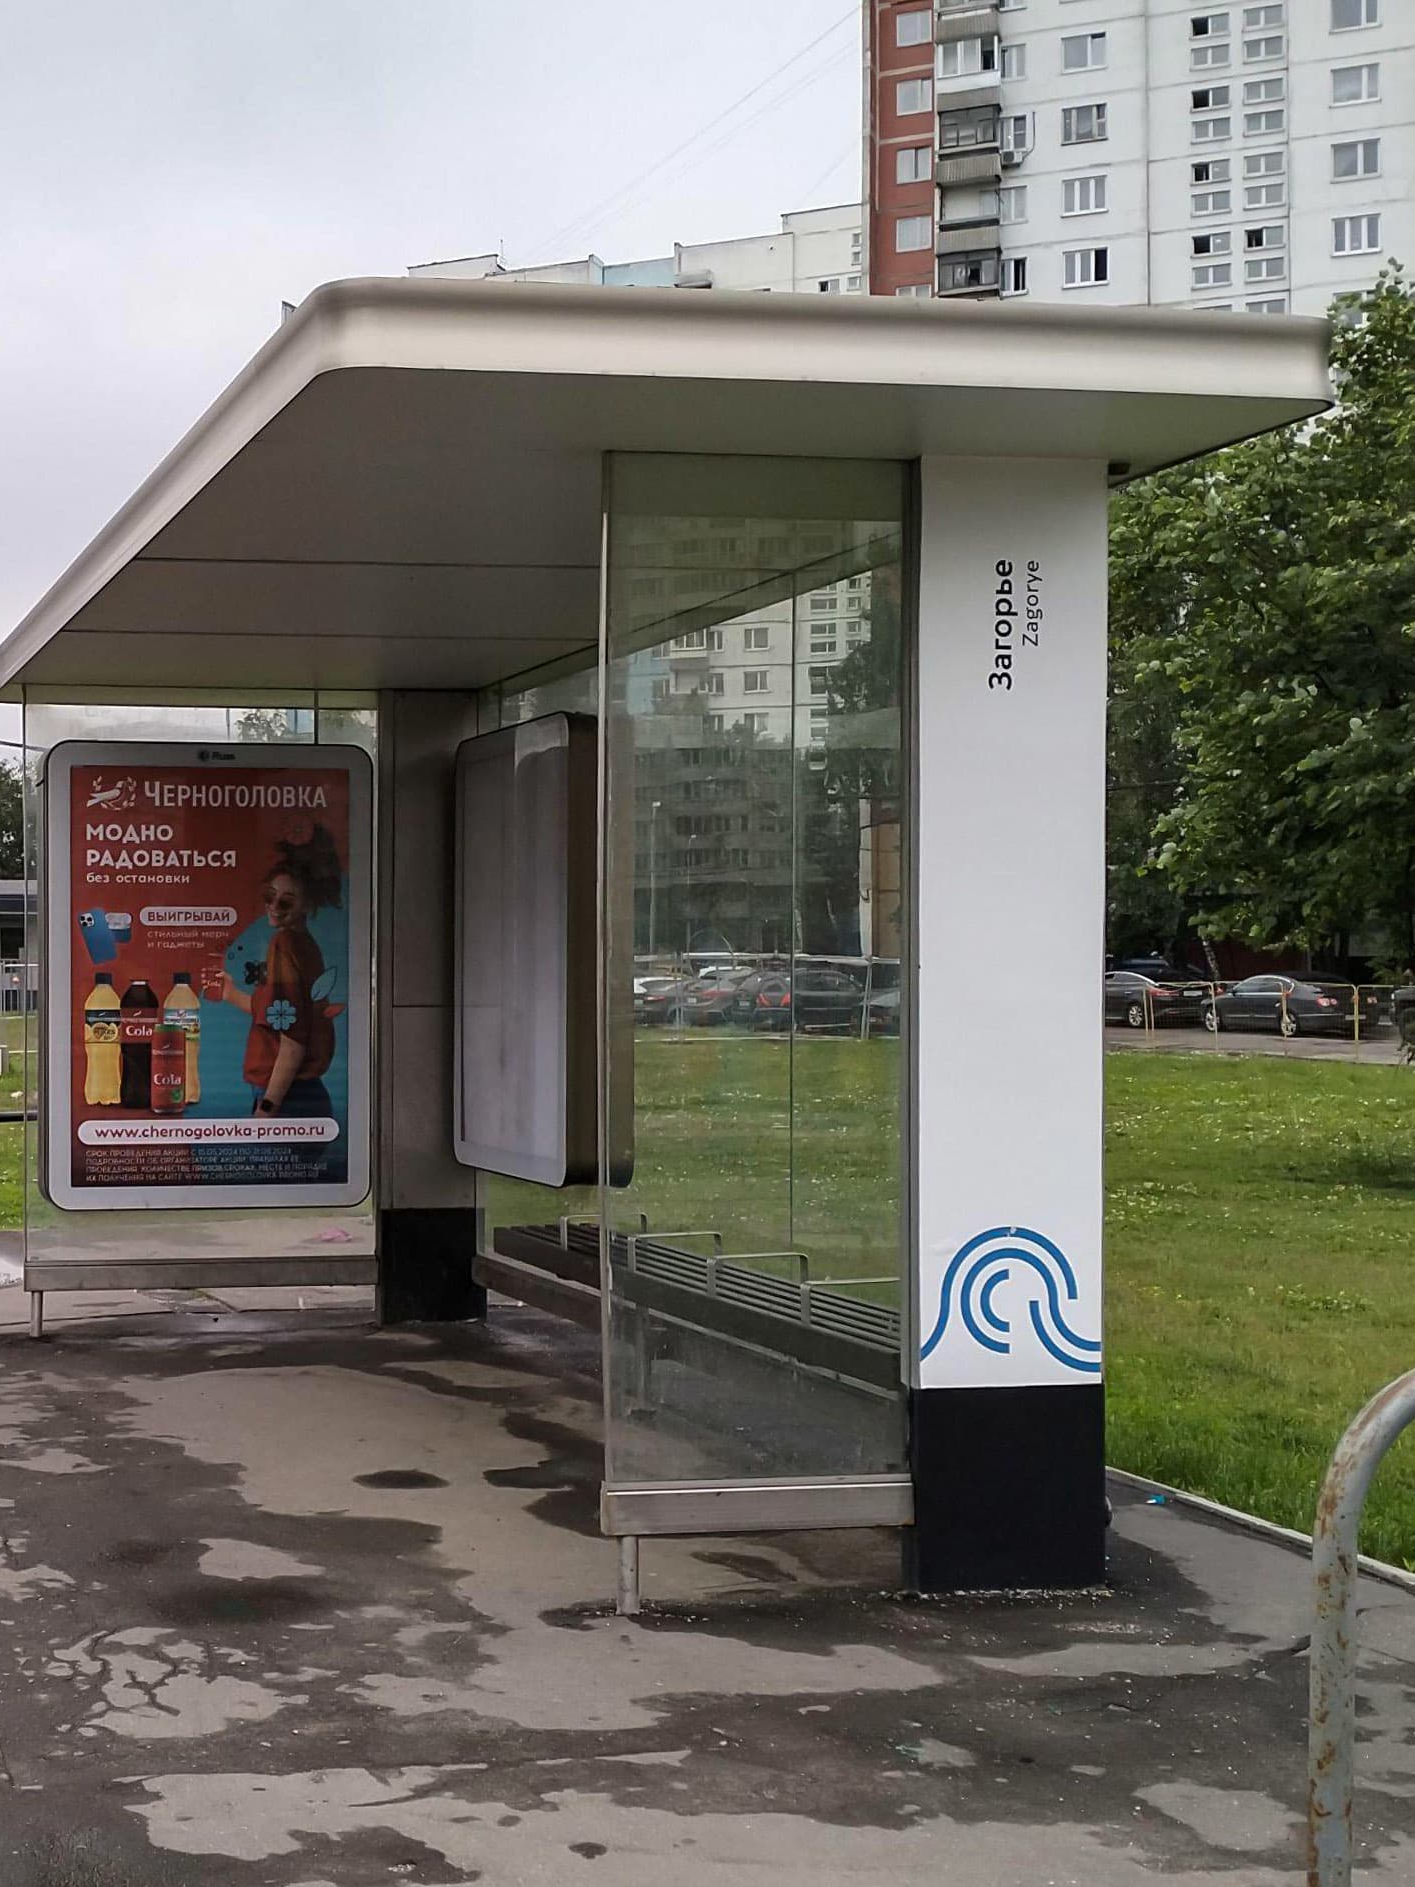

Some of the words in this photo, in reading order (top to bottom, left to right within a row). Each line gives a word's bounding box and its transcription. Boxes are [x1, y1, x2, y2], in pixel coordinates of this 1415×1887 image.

[1022, 560, 1043, 646] Zagorye
[988, 559, 1018, 690] Загорье
[144, 781, 327, 807] ЧЕРНОГОЛОВКА
[86, 823, 174, 844] МОДНО
[86, 849, 236, 869] РАДОВАТЬСЯ
[86, 872, 110, 884] без
[116, 873, 190, 884] остановки
[147, 909, 230, 922] ВЫИГРЫВАЙ
[126, 1025, 153, 1036] Cola
[153, 1073, 182, 1085] Cola
[94, 1124, 325, 1140] www.chernogolovka-promo.ru
